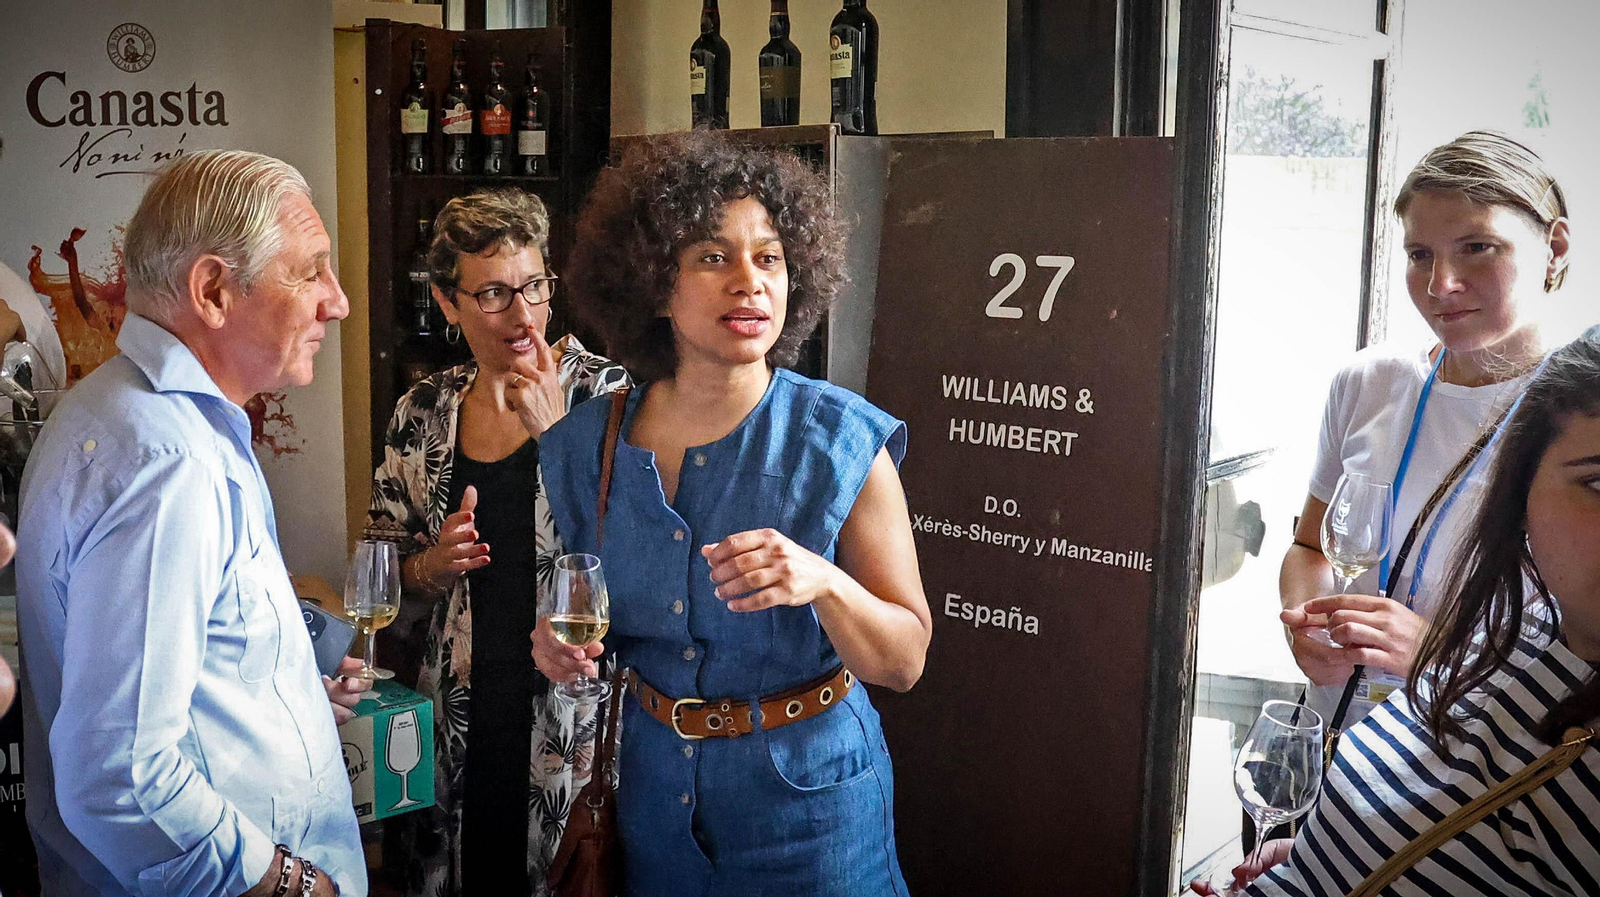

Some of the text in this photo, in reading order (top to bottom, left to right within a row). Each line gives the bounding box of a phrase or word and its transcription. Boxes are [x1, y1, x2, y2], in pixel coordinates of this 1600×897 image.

[110, 51, 152, 71] HUMBERT
[26, 71, 229, 127] Canasta
[985, 253, 1075, 322] 27
[942, 374, 1094, 414] WILLIAMS &
[949, 418, 1078, 456] HUMBERT
[984, 495, 1021, 518] D.O.
[1034, 538, 1046, 557] y
[1051, 538, 1152, 572] Manzanilla
[944, 593, 1040, 635] España
